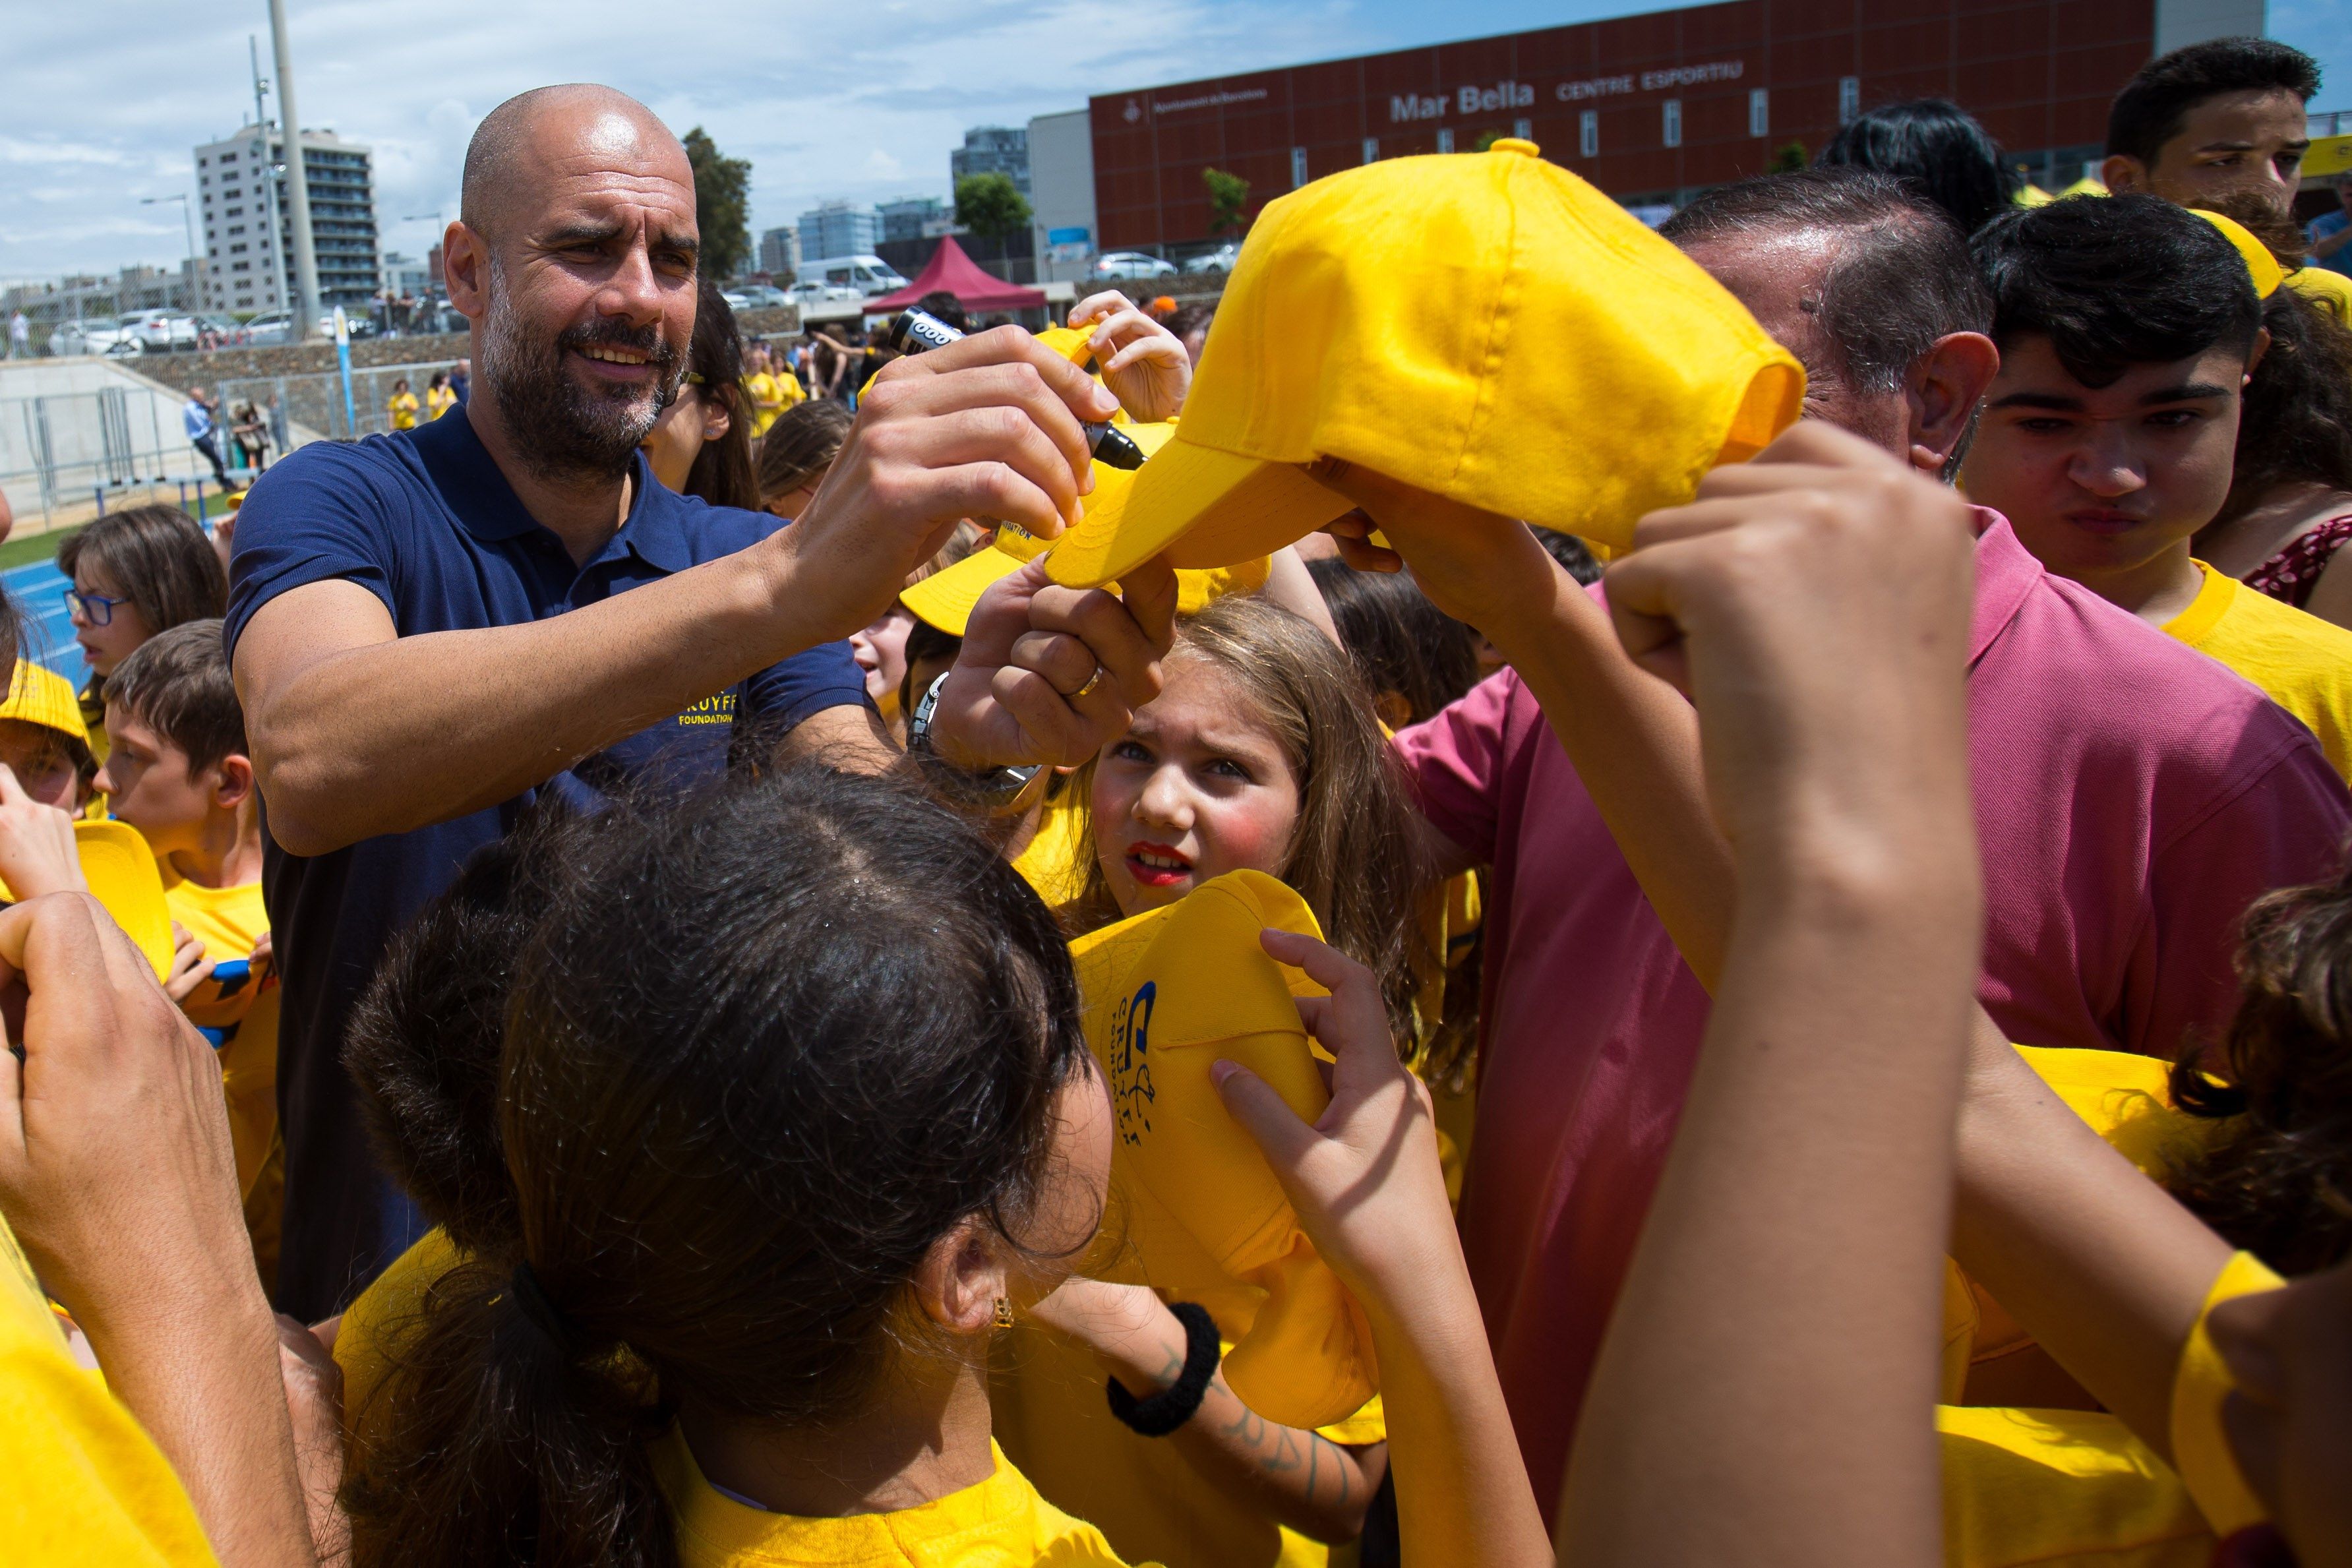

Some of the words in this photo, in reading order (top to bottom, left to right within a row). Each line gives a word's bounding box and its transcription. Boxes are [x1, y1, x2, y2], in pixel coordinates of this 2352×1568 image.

[1389, 93, 1450, 123] Mar
[1457, 80, 1535, 115] Bella
[1555, 74, 1636, 102] CENTRE
[1641, 59, 1744, 91] ESPORTIU
[678, 714, 733, 726] FOUNDATION
[1110, 1012, 1130, 1145] FOUNDATION
[1116, 996, 1141, 1147] CRUYFF
